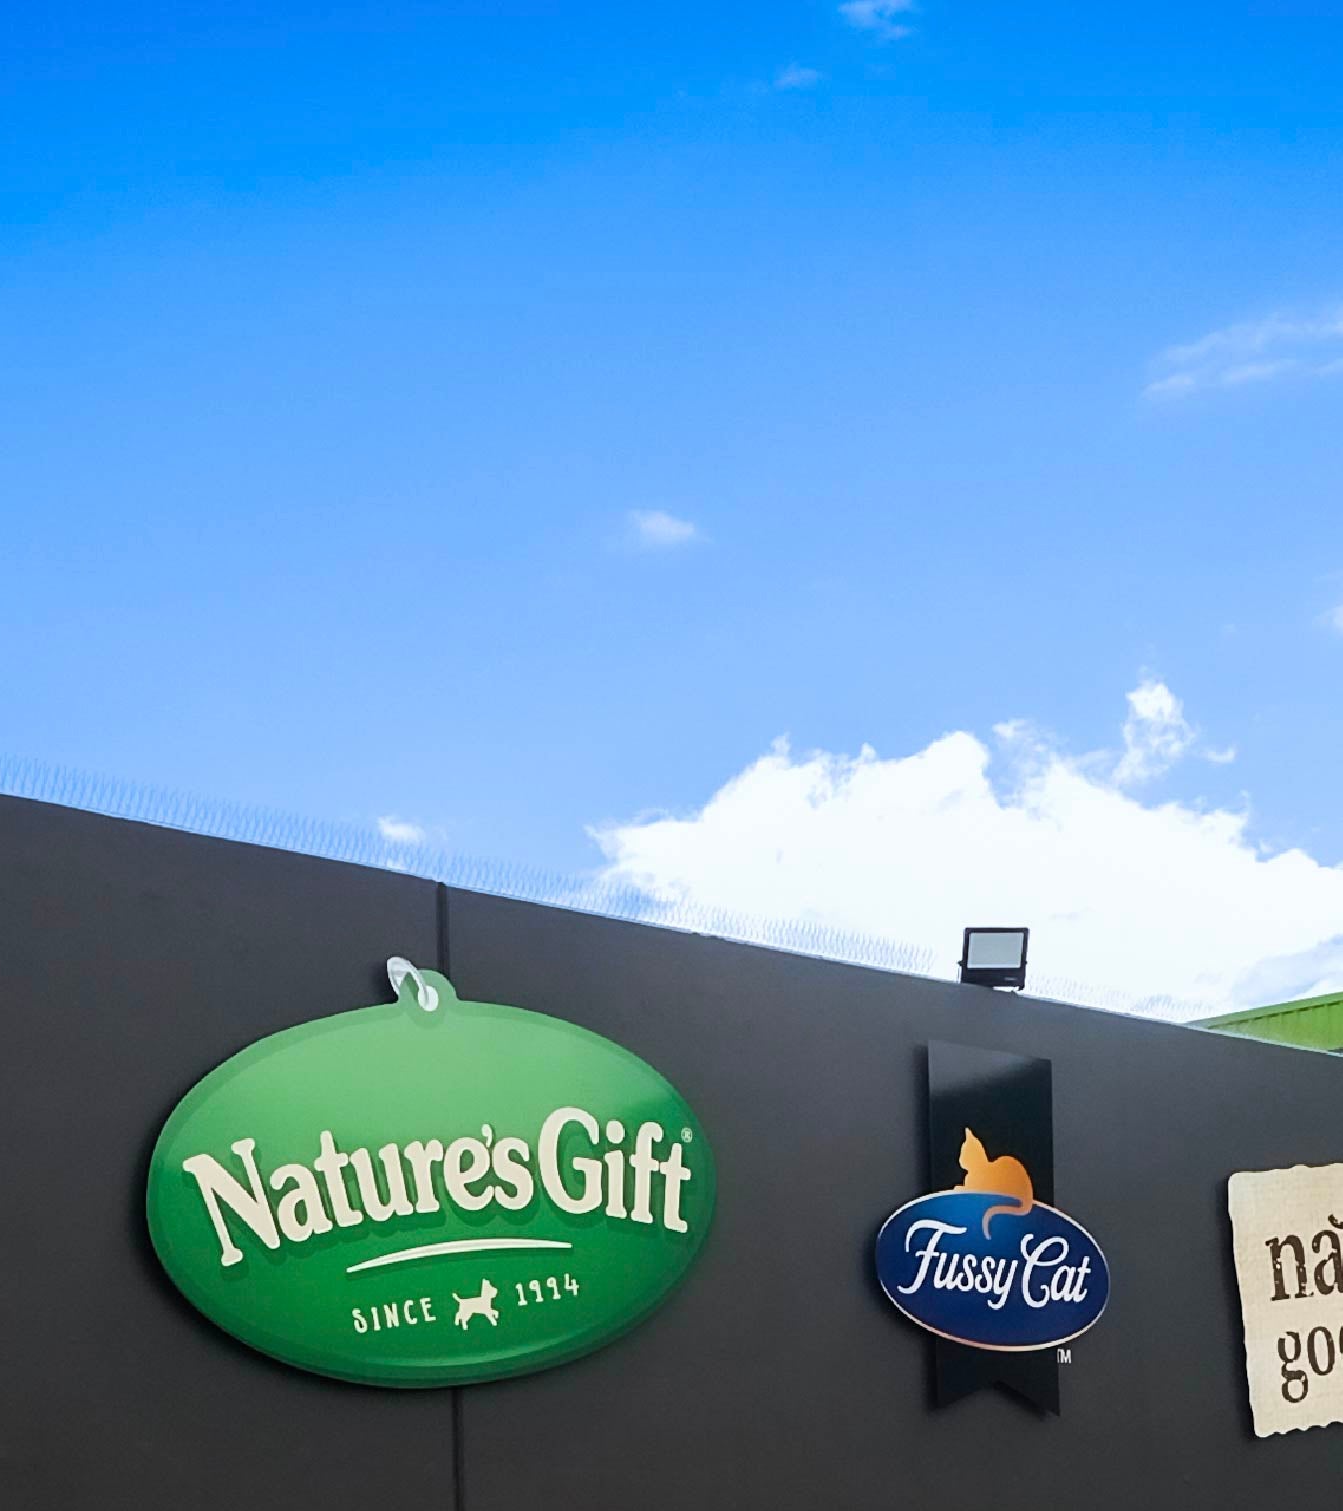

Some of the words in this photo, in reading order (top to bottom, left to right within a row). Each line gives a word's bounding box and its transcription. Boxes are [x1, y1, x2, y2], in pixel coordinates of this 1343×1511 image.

[182, 1123, 535, 1268] Nature's
[538, 1106, 692, 1234] Gift
[351, 1296, 437, 1334] SINCE
[515, 1272, 580, 1306] 1994
[897, 1219, 1018, 1311] Fussy
[1020, 1233, 1092, 1309] Cat
